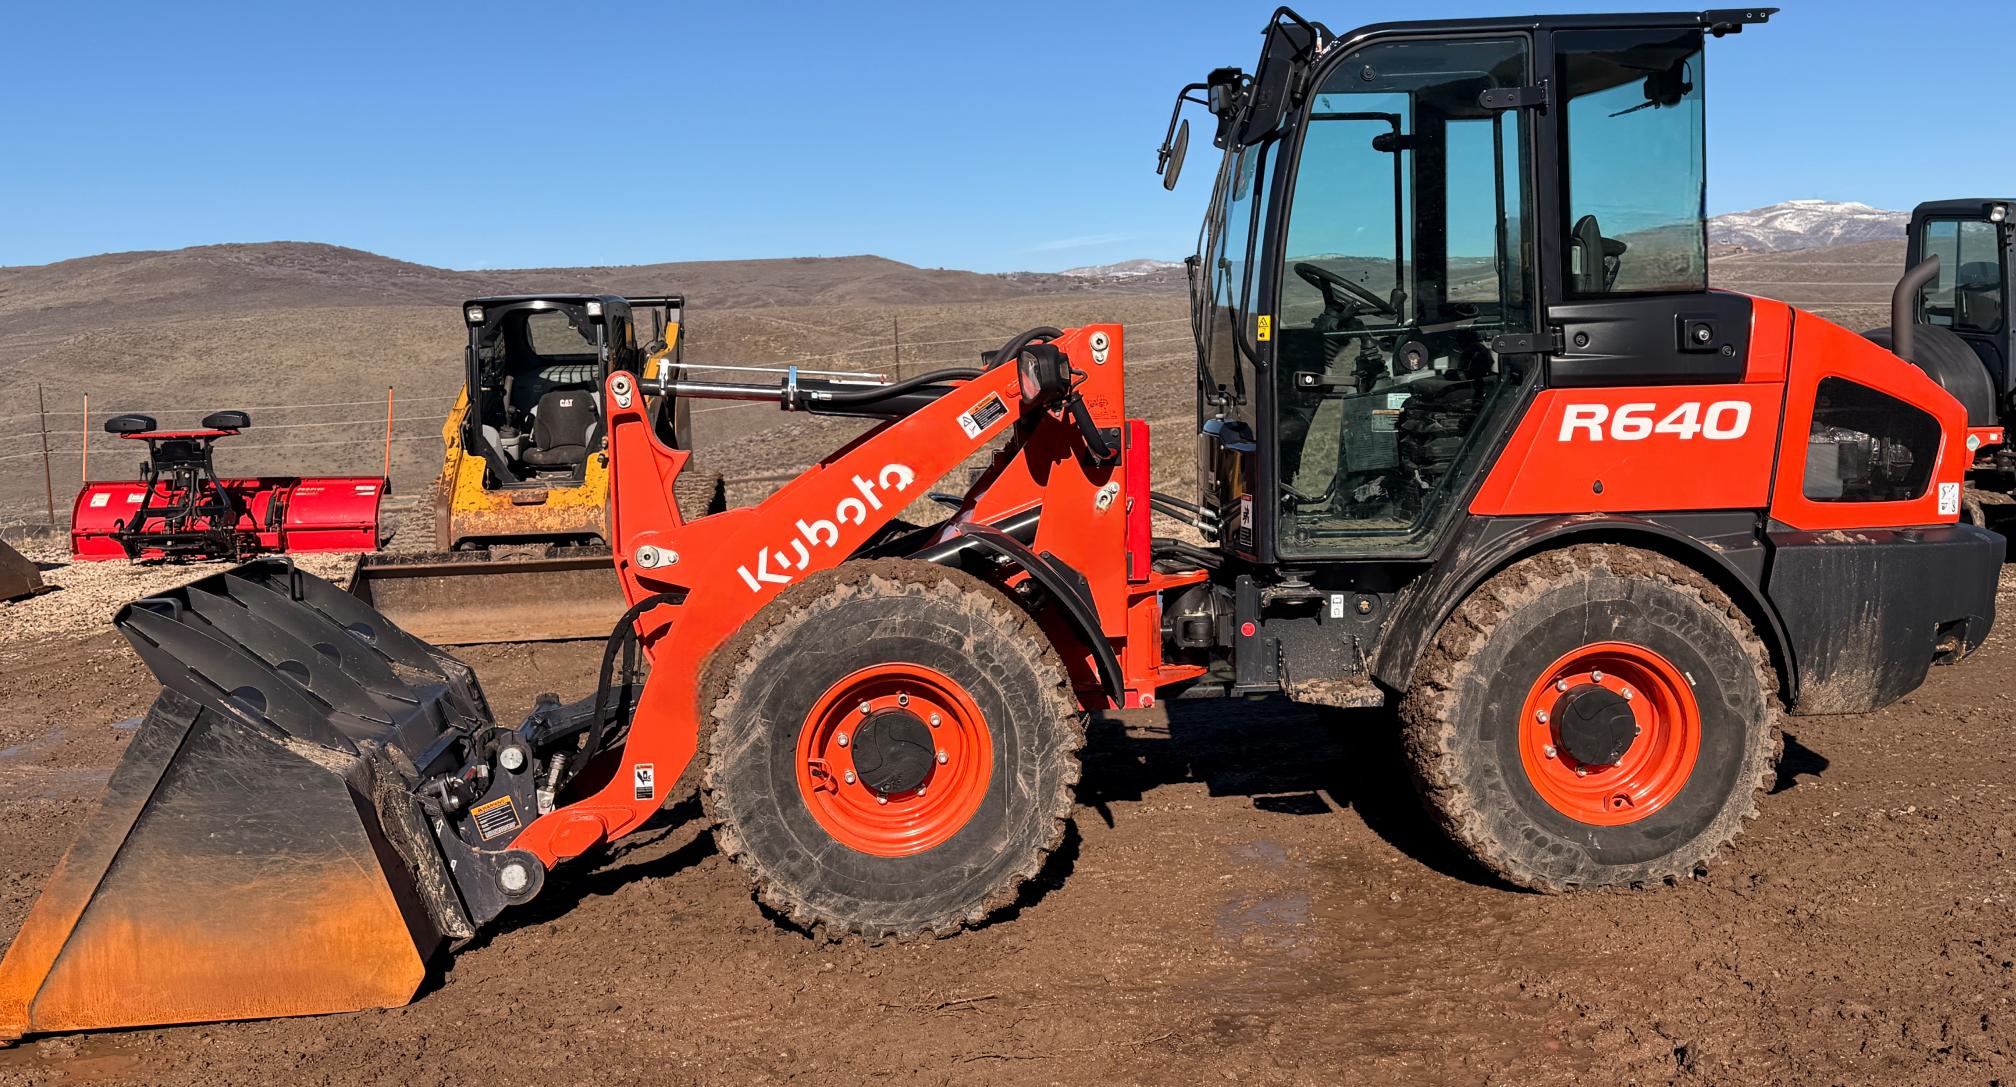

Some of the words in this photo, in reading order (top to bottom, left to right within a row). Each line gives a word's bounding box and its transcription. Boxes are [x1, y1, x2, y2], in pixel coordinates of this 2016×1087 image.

[559, 398, 574, 408] CAT
[1558, 400, 1752, 442] R640
[736, 463, 914, 593] Kubota
